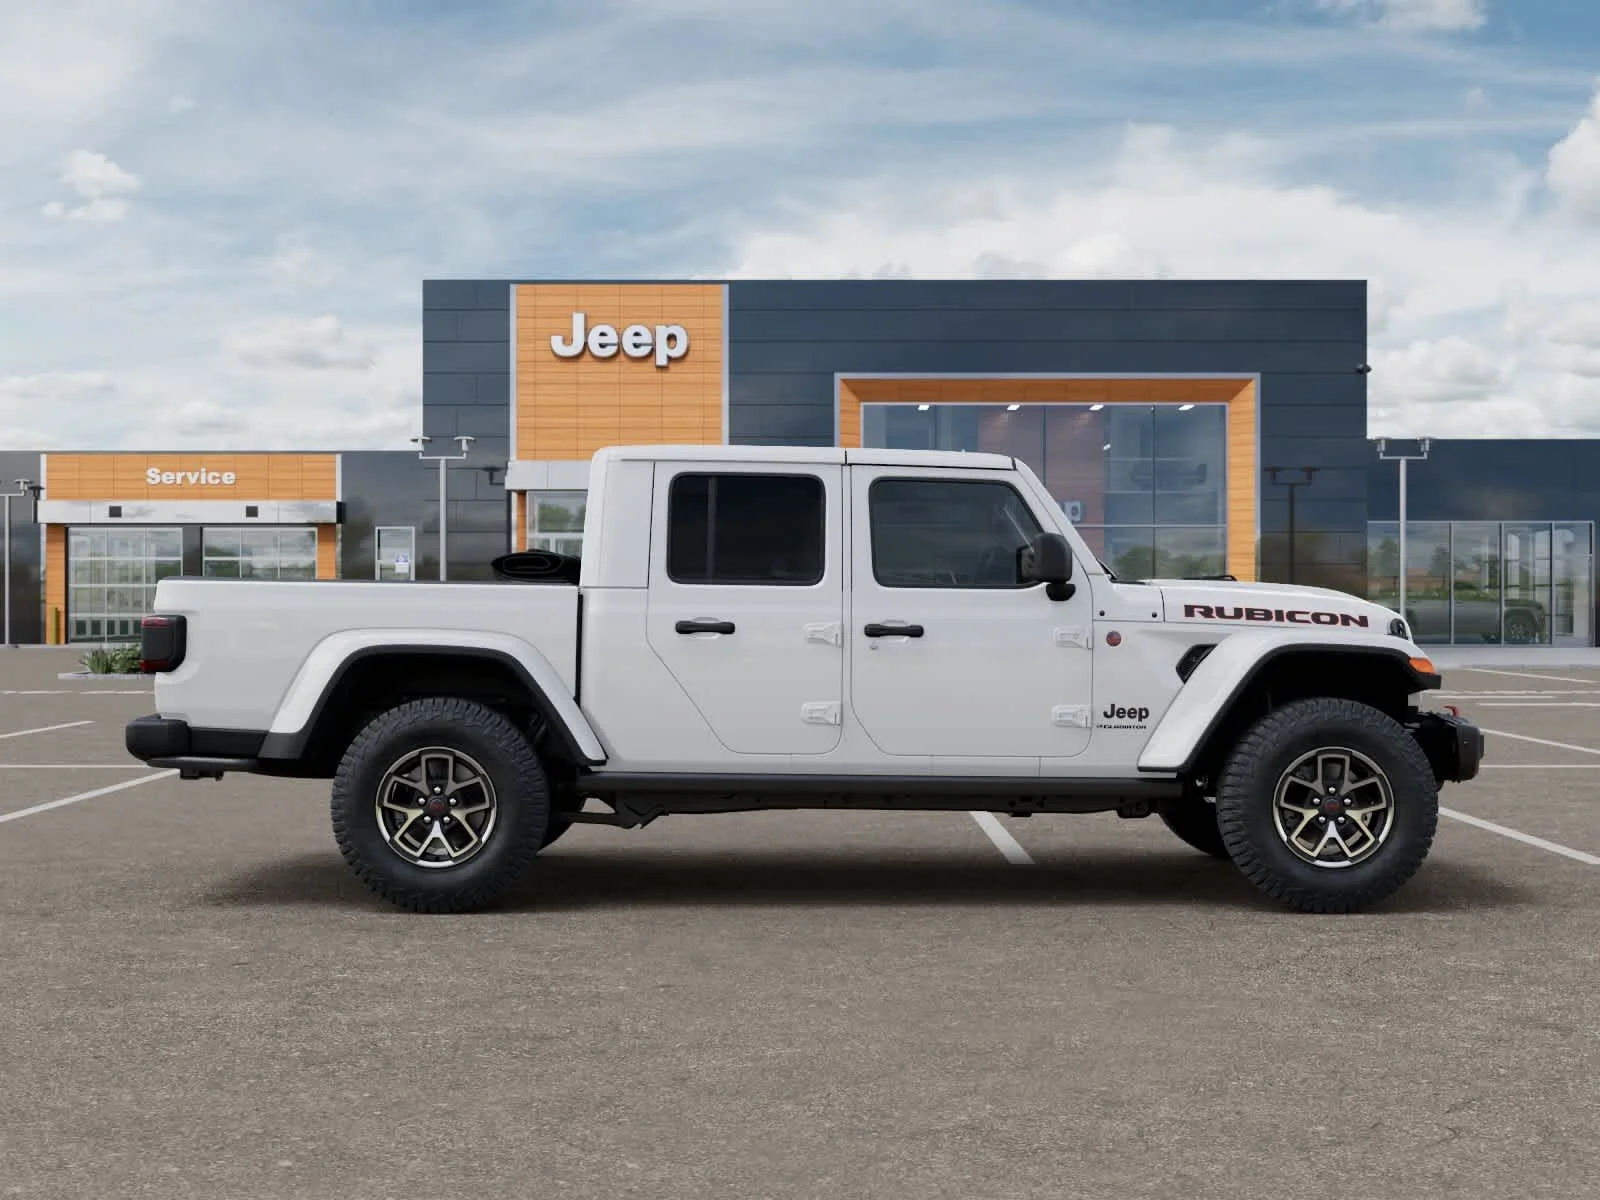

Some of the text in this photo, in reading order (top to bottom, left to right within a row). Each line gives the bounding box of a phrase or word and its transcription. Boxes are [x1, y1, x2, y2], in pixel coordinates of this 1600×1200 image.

[550, 311, 689, 367] Jeep
[146, 467, 236, 485] Service
[1184, 604, 1369, 628] RUBICON
[1103, 703, 1149, 722] Jeep
